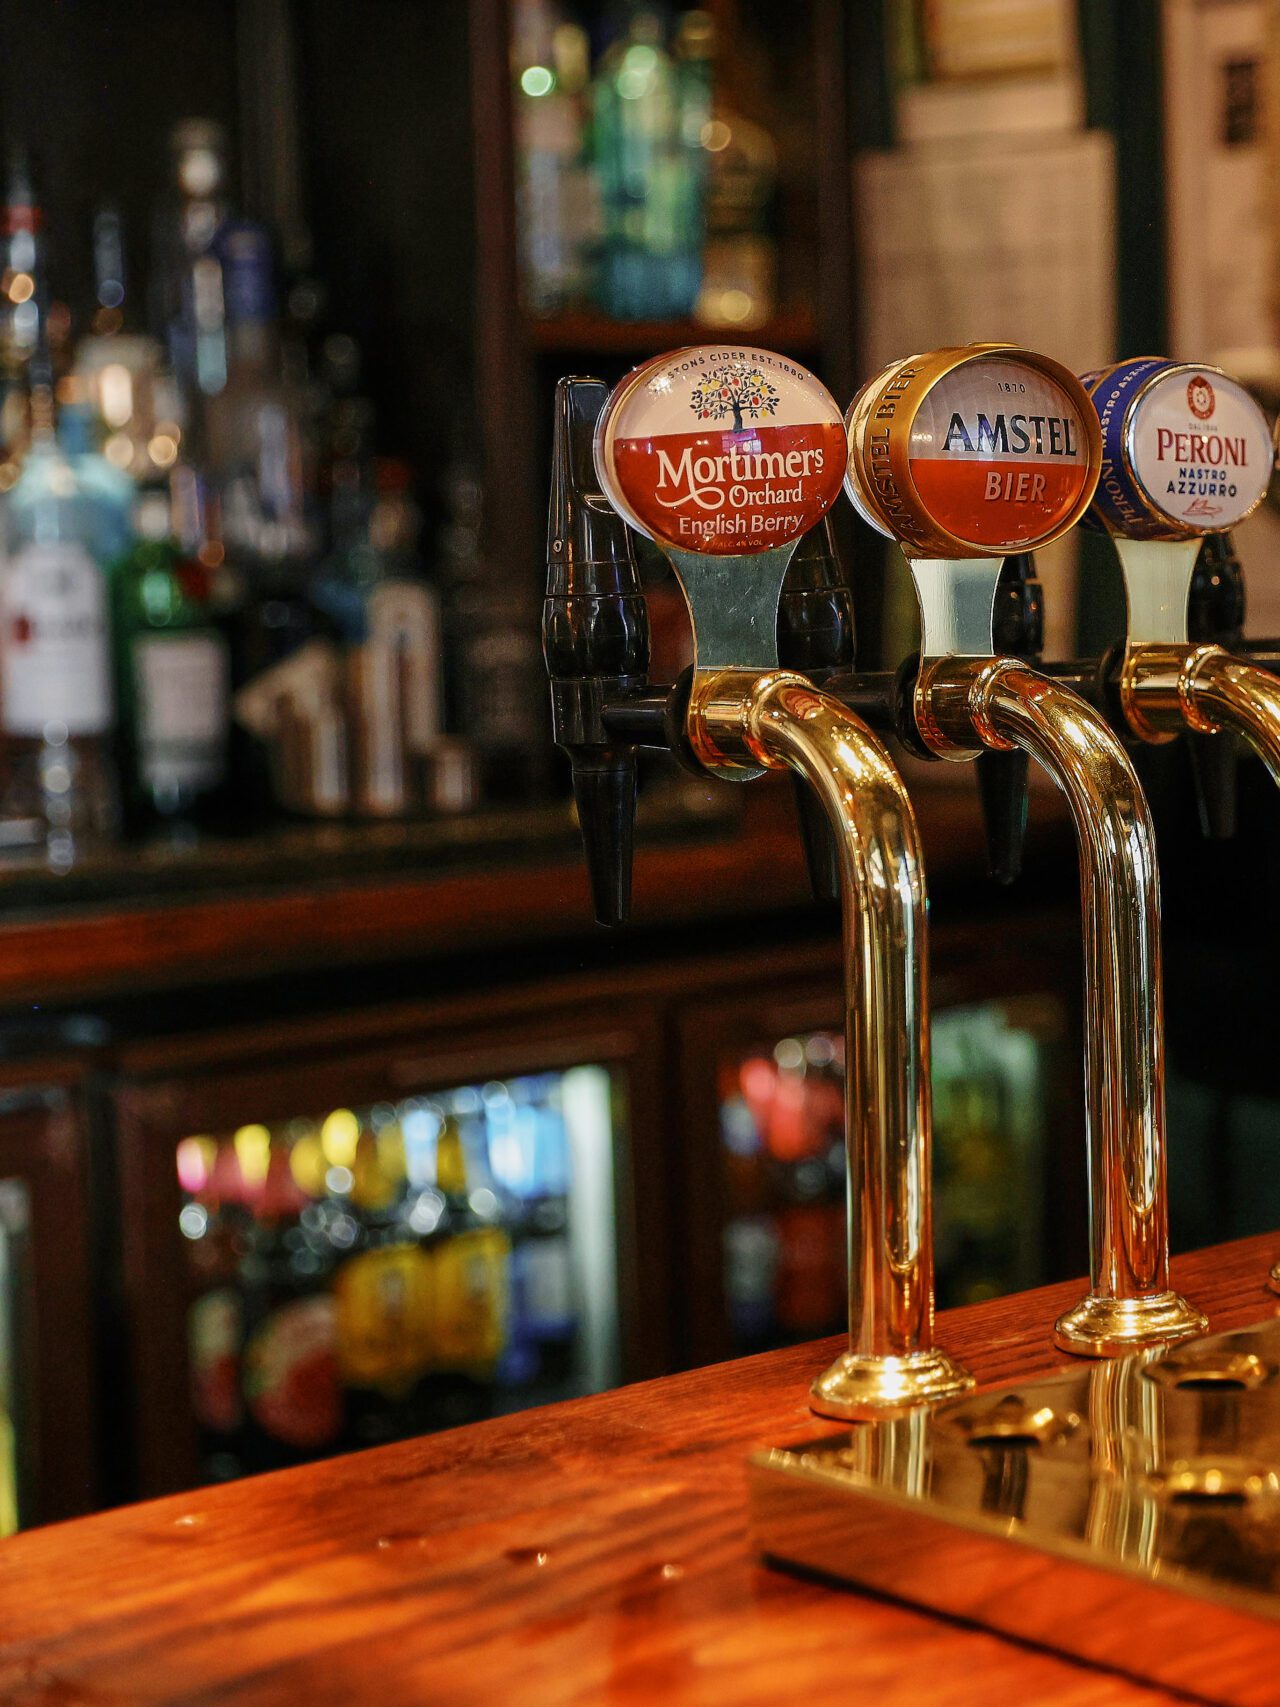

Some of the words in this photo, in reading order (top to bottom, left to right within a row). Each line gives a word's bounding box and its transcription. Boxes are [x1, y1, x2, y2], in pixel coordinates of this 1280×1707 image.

[667, 356, 705, 379] STONS
[710, 352, 746, 362] CIDER
[751, 353, 776, 367] EST.
[778, 361, 804, 381] 1880
[1118, 361, 1159, 389] AZZUR
[874, 365, 926, 420] BIER
[996, 382, 1026, 393] 1870
[942, 412, 1078, 457] AMSTEL
[1157, 428, 1248, 467] PERONI
[655, 442, 824, 510] Mortimers
[984, 471, 1047, 503] BIER
[1179, 467, 1227, 480] NASTRO
[728, 481, 803, 508] Orchard
[1166, 481, 1238, 498] AZZURRO
[679, 513, 746, 540] English
[751, 514, 804, 534] Berry
